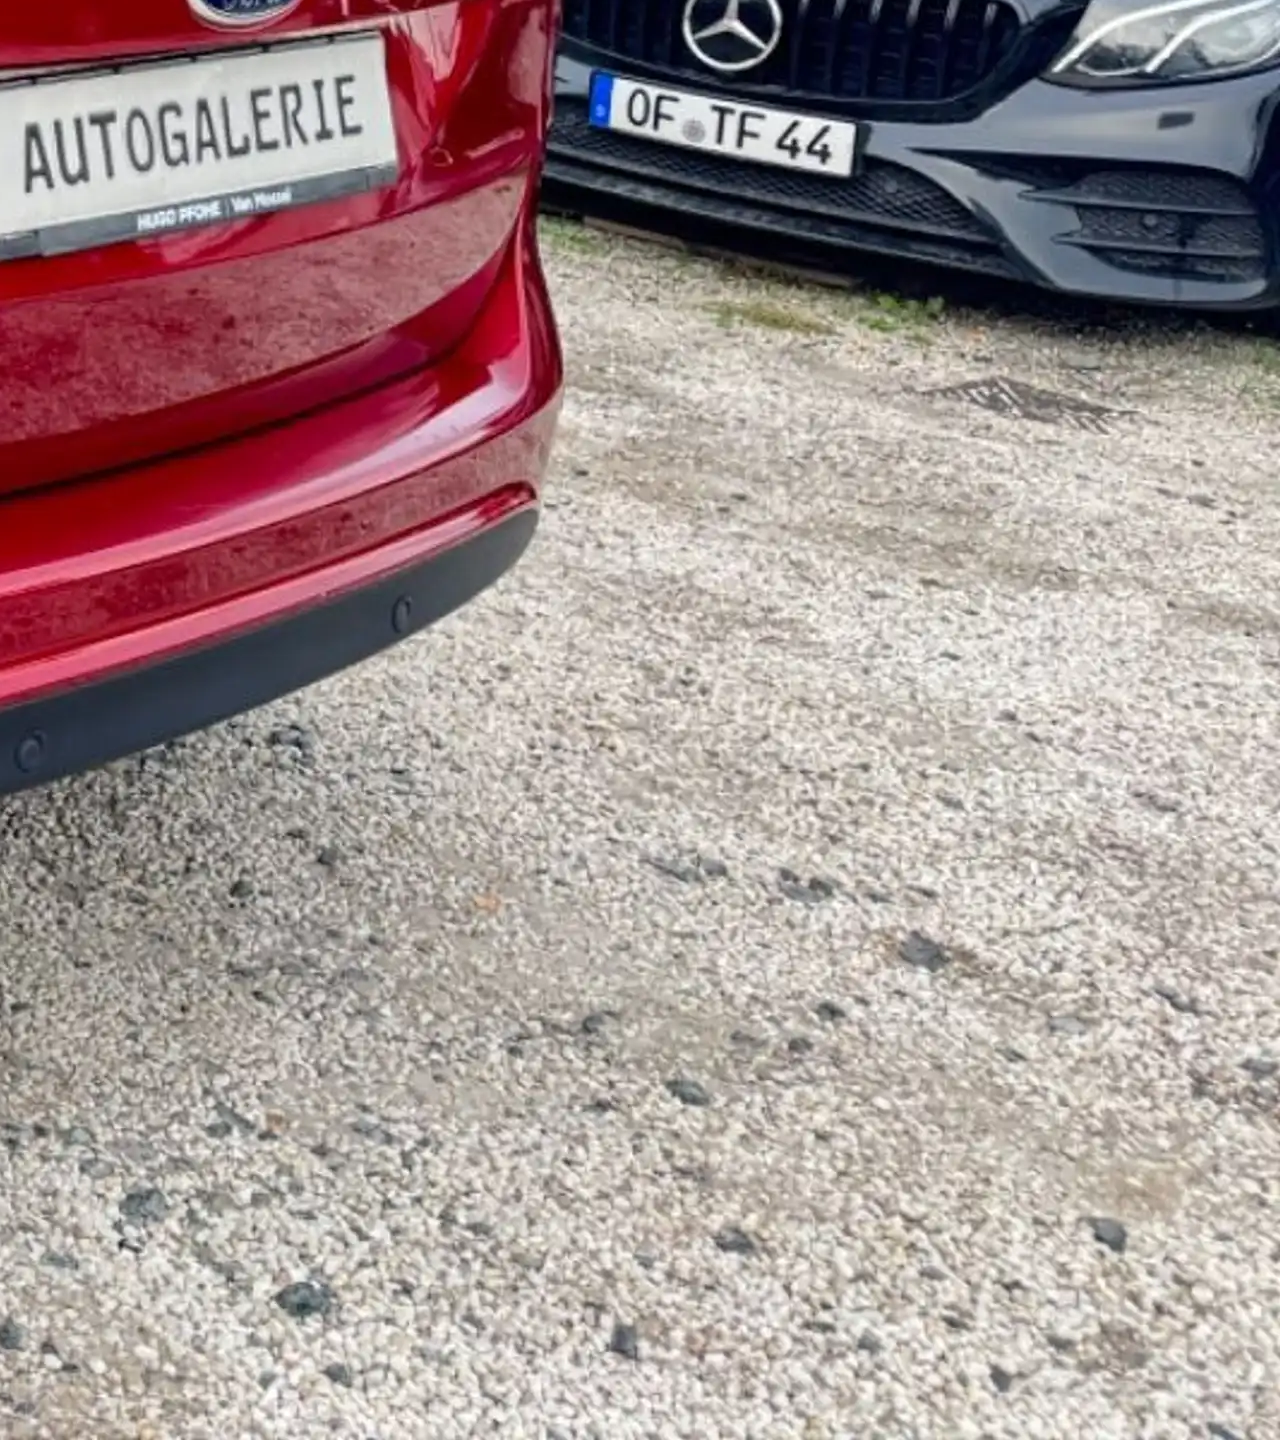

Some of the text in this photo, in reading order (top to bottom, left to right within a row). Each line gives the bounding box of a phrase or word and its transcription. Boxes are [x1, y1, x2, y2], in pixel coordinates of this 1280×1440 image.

[22, 74, 363, 194] AUTOGALERIE
[626, 88, 833, 165] OF TF 44
